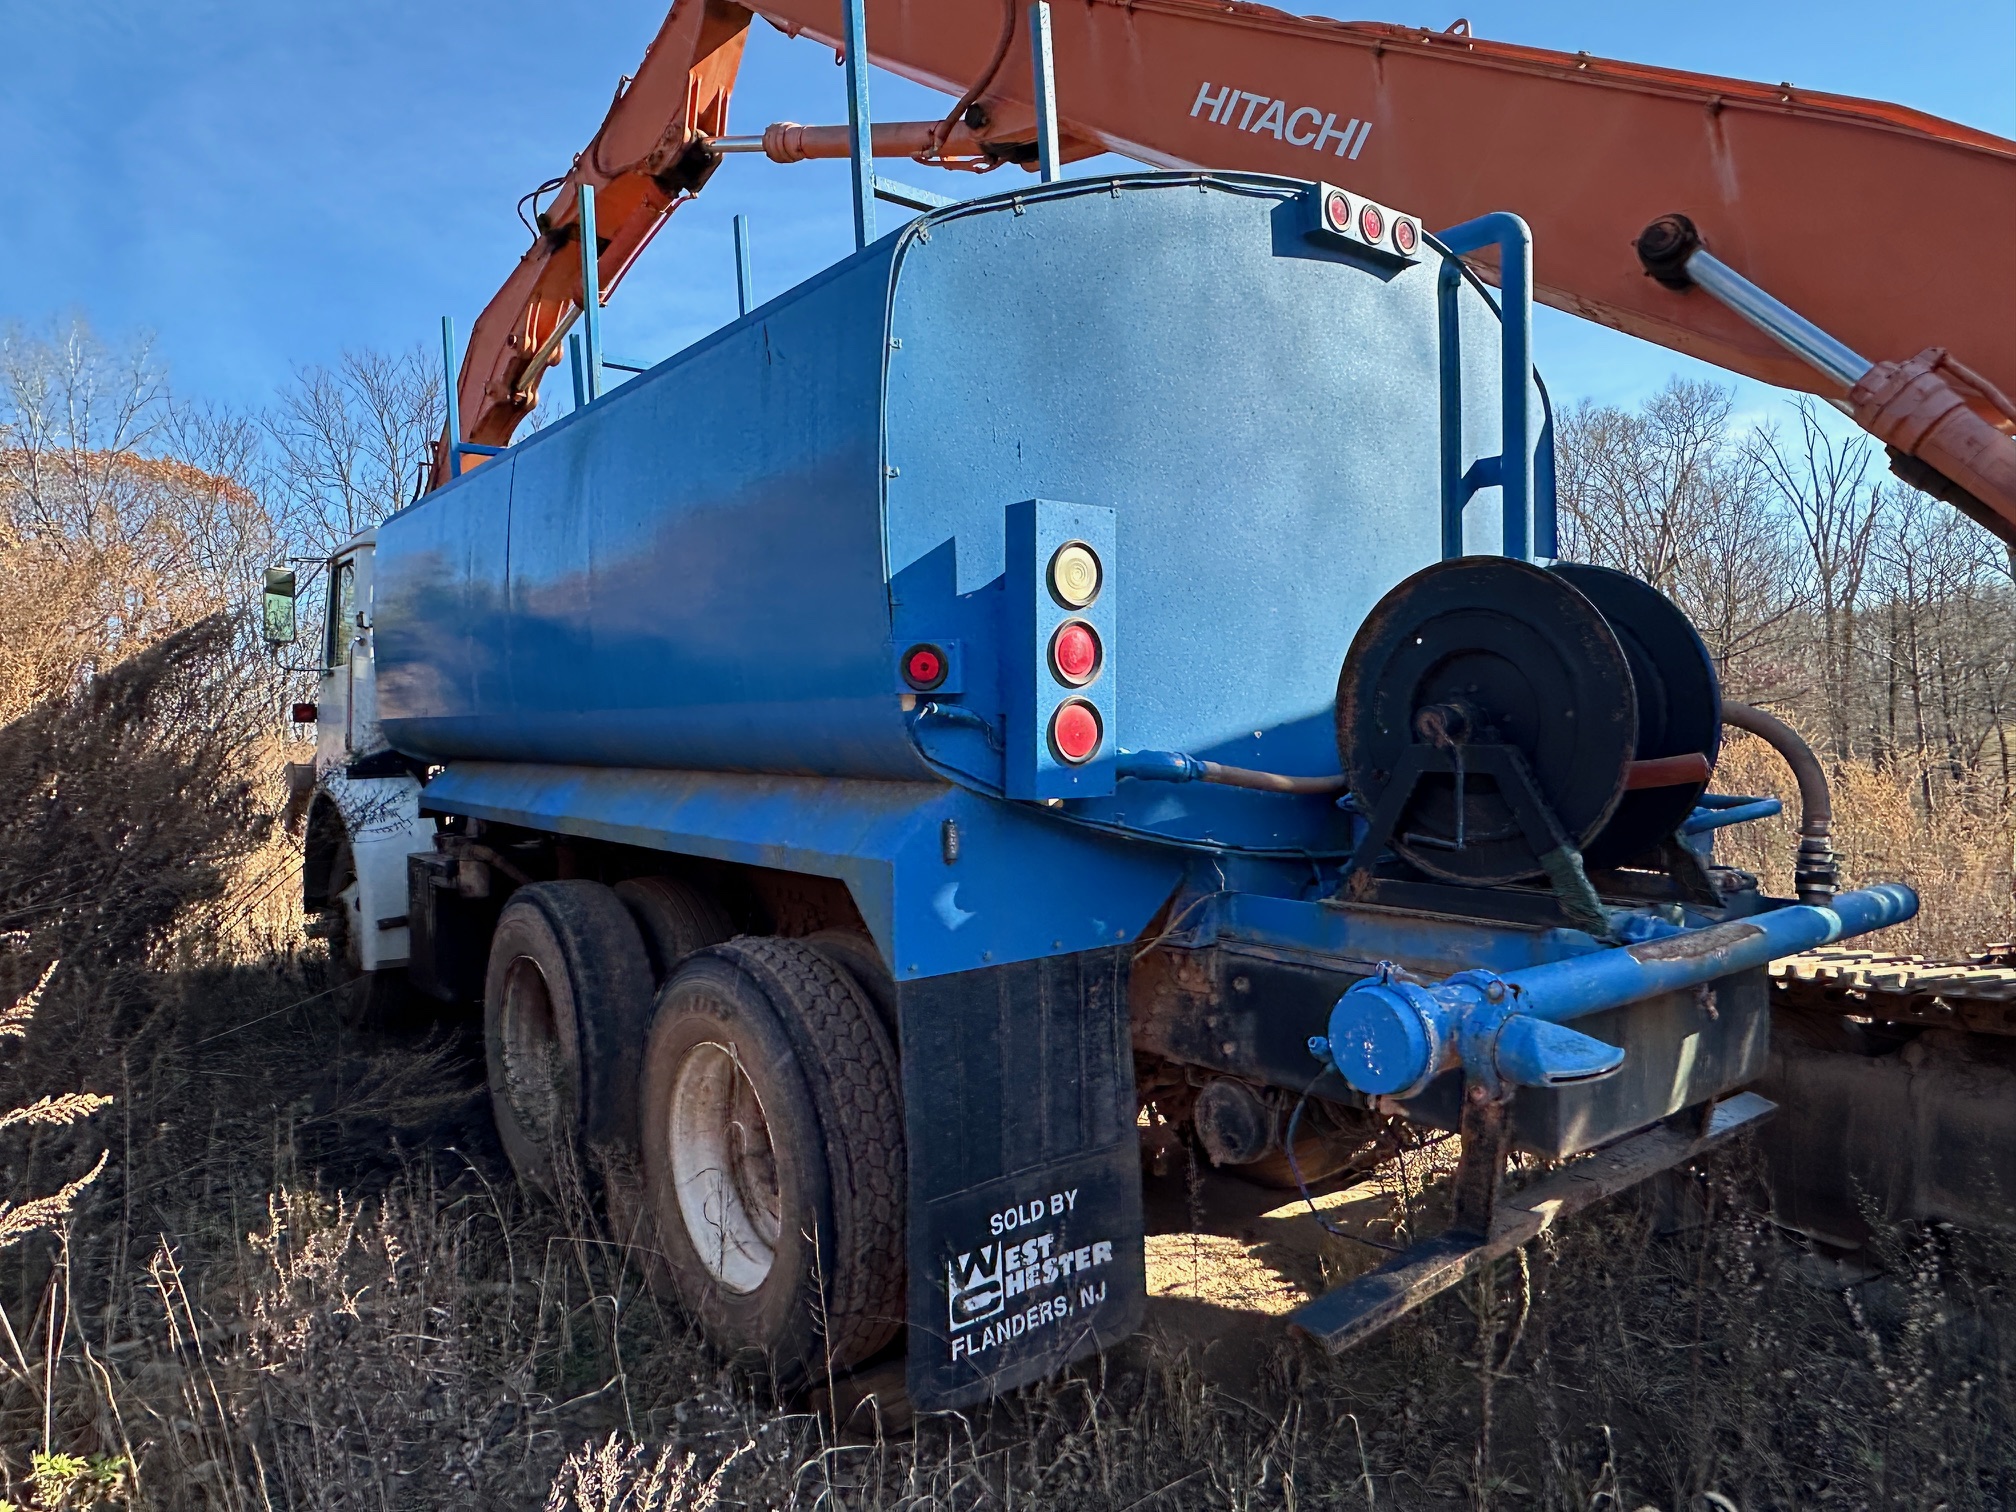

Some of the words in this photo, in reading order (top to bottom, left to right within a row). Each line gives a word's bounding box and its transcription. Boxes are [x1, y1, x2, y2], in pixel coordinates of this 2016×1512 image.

[1189, 81, 1373, 160] HITACHI
[990, 1199, 1045, 1236] SOLD
[1050, 1188, 1078, 1216] BY
[951, 1296, 1074, 1361] FLANDERS,
[1080, 1281, 1106, 1308] NJ
